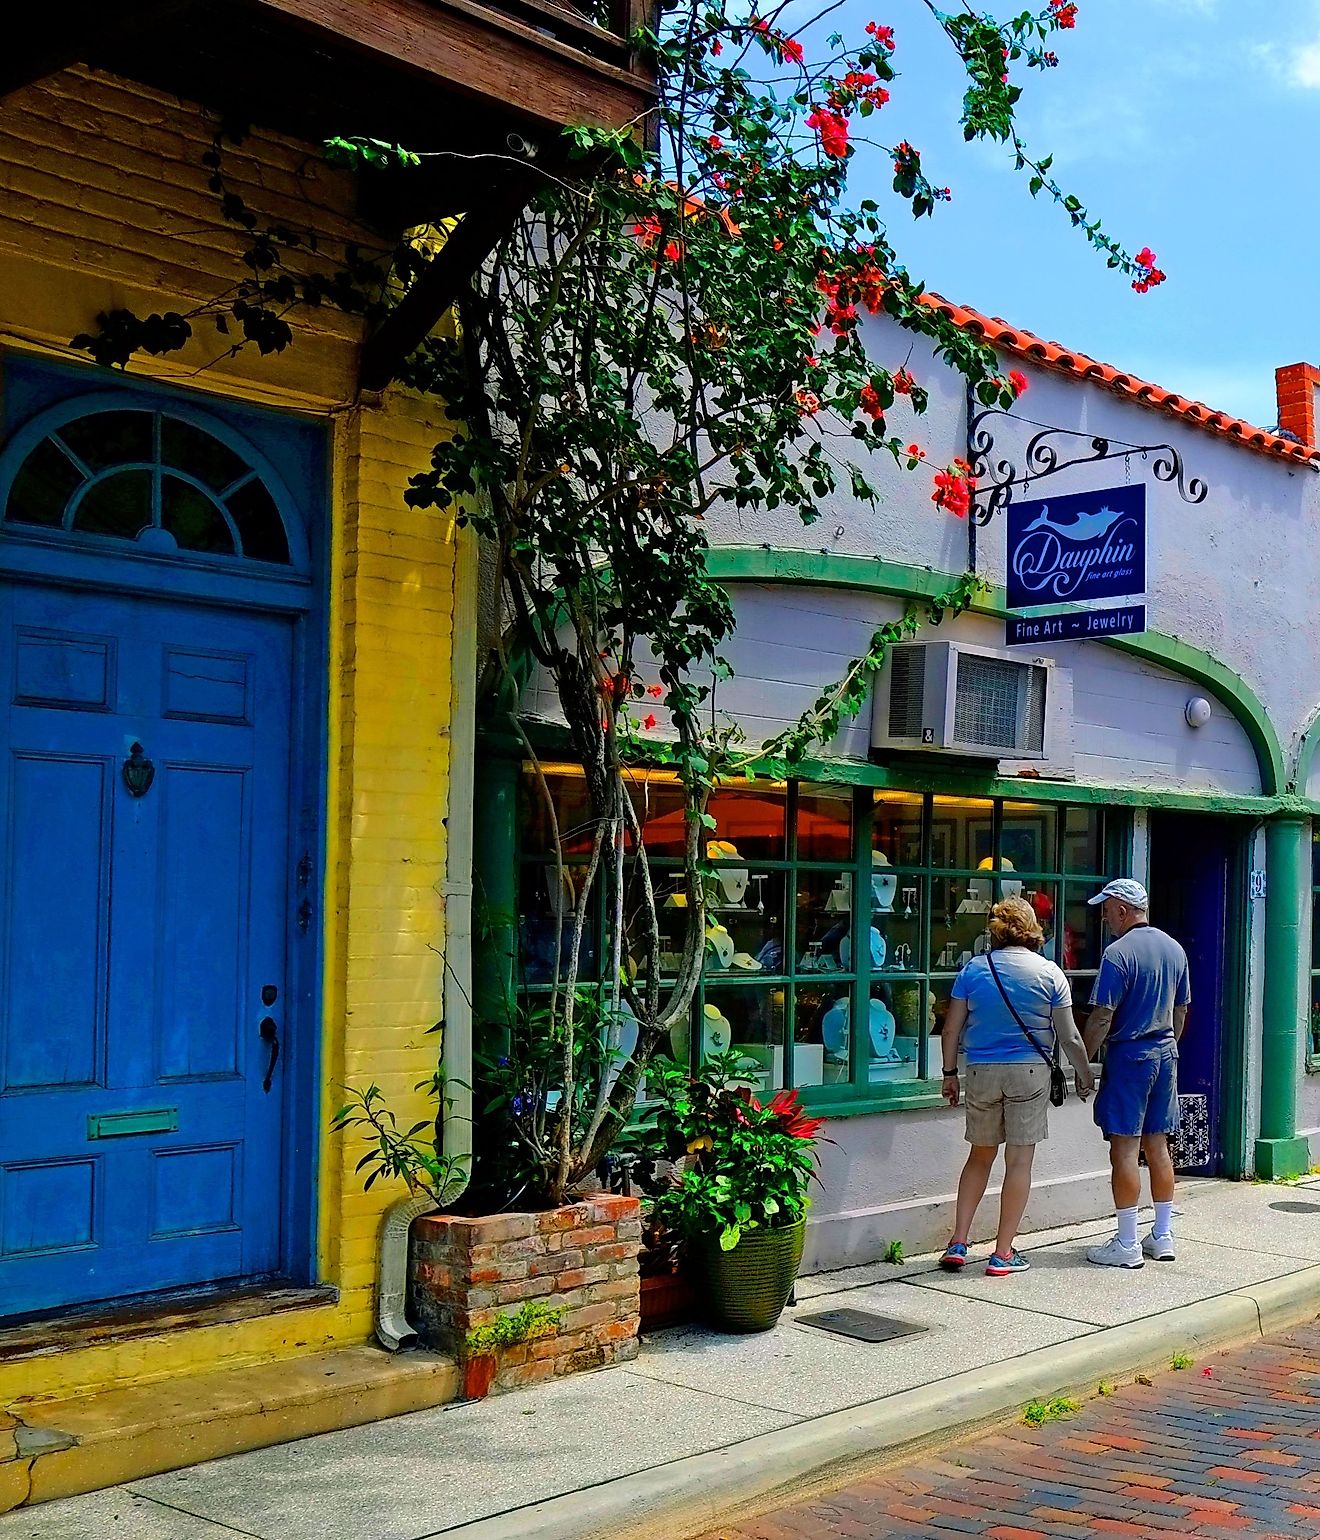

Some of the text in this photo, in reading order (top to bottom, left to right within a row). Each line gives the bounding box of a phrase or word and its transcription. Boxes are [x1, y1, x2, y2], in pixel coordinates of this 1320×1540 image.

[1013, 518, 1137, 596] Dauphin
[1085, 568, 1133, 581] fine art glass
[1016, 623, 1039, 637] Fine
[1044, 620, 1063, 634] Art
[1087, 612, 1134, 631] Jewelry
[1255, 875, 1262, 893] 9
